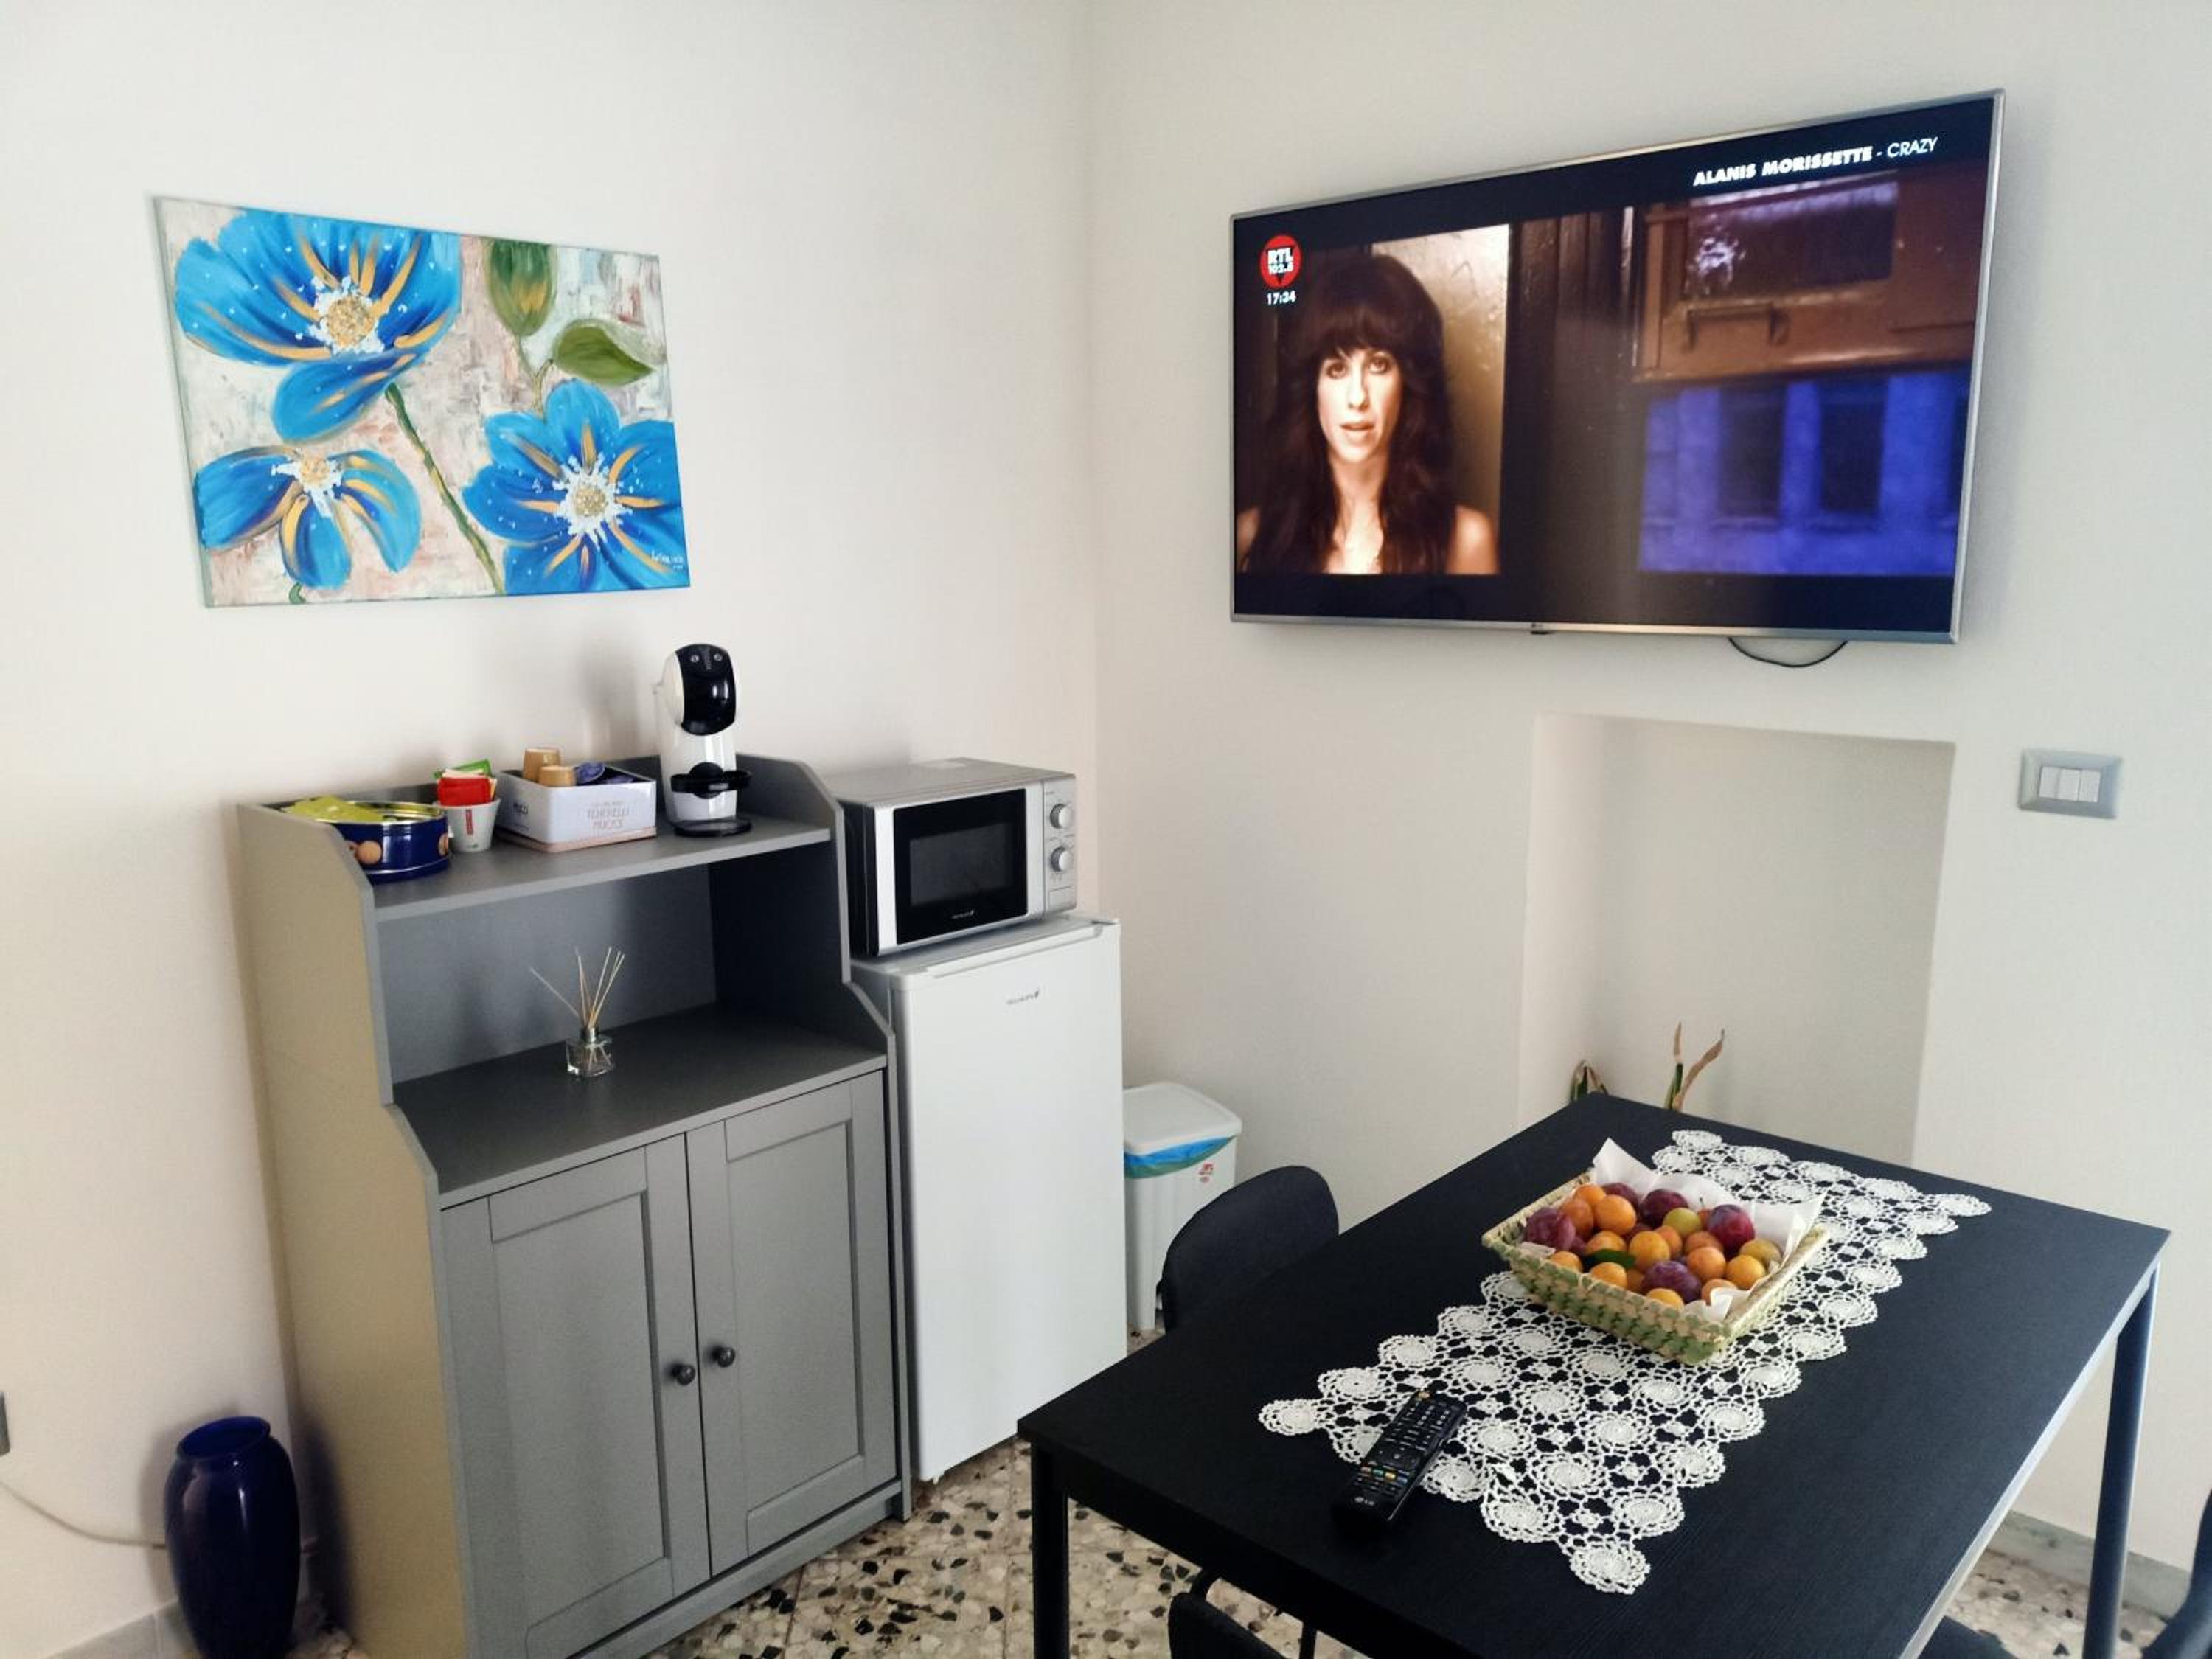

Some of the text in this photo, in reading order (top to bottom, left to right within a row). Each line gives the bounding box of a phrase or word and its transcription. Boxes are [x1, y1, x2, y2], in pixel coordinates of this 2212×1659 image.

[1693, 163, 1756, 187] ALANIS
[1761, 146, 1874, 176] MORISSETTE
[1887, 136, 1938, 159] CRAZY
[1267, 247, 1294, 265] RTL
[1267, 290, 1297, 305] 17:34
